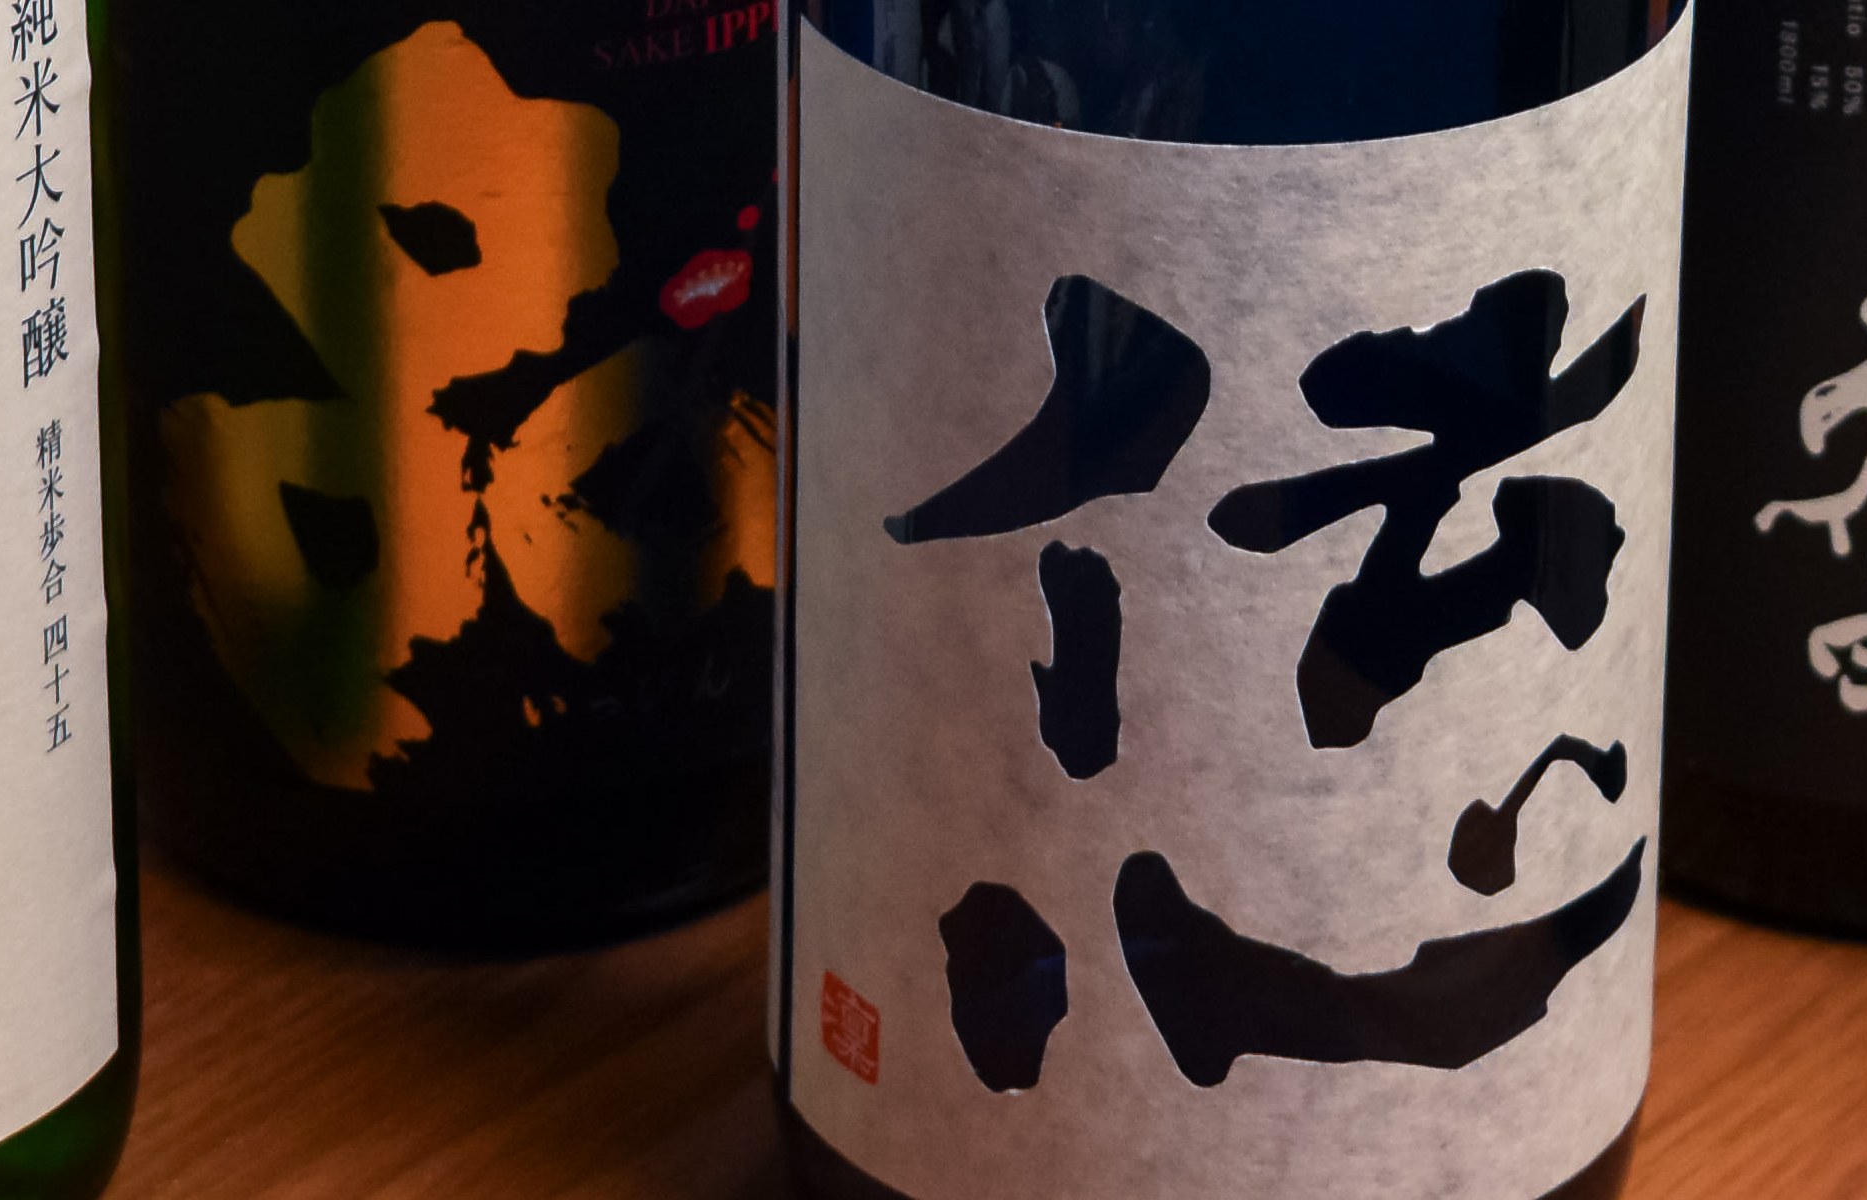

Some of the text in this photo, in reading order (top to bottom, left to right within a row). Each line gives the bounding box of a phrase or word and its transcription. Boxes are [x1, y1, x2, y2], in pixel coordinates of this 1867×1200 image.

[35, 418, 65, 606] 精米歩合
[41, 614, 73, 755] 四十五
